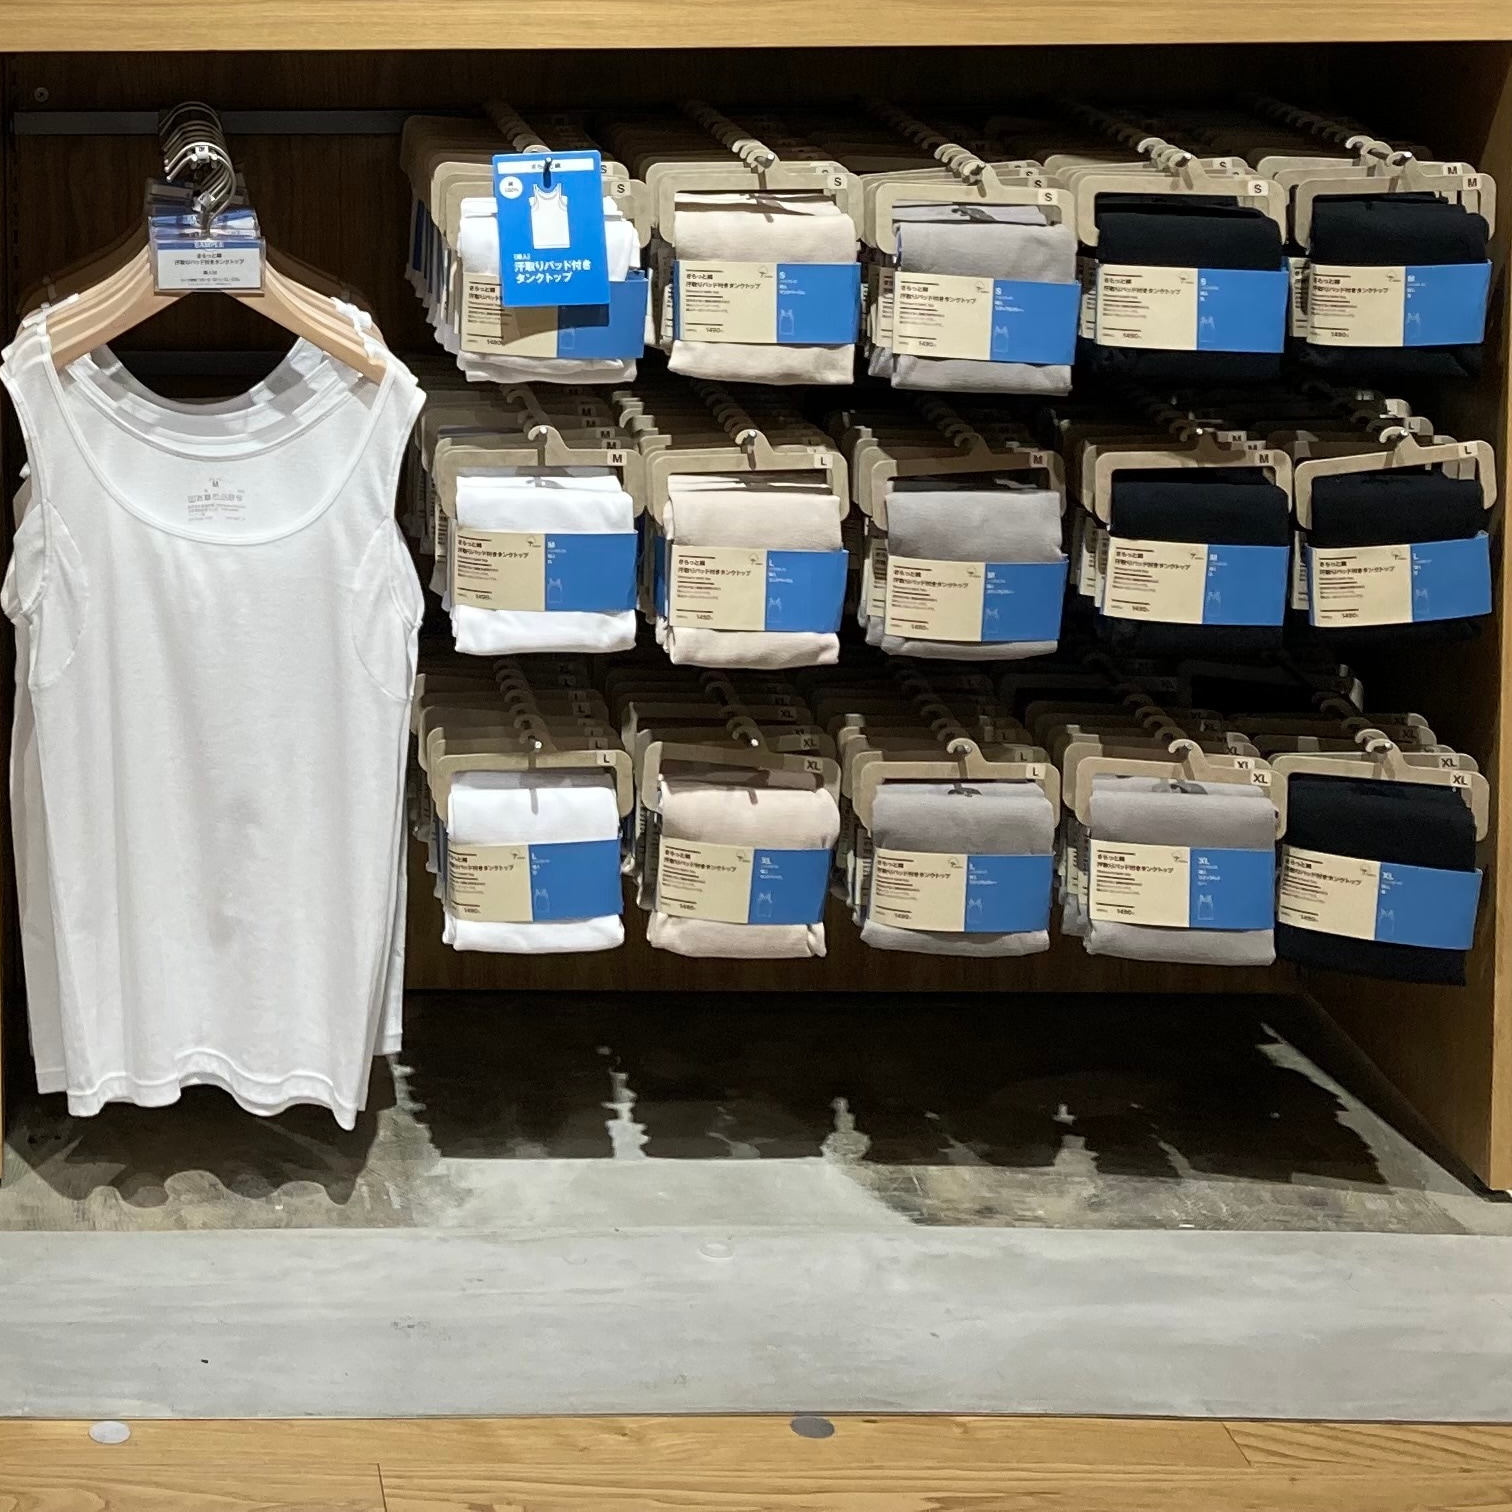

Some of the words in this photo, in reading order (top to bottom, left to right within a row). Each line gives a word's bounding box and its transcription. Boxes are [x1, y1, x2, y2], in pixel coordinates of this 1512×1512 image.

[834, 177, 842, 187] S
[1467, 178, 1478, 187] M
[616, 184, 625, 194] S
[1254, 184, 1262, 193] S
[1044, 192, 1053, 202] S
[514, 259, 591, 273] 汗取りパッド付き
[516, 271, 573, 284] タンクトップ
[1465, 446, 1472, 454] L
[613, 454, 622, 463] M
[820, 457, 827, 466] L
[1033, 456, 1043, 464] M
[1259, 454, 1269, 463] M
[803, 739, 816, 747] XL
[603, 754, 610, 763] L
[1020, 752, 1028, 760] L
[807, 760, 822, 769] XL
[1441, 758, 1457, 767] XL
[1032, 767, 1039, 776] L
[1253, 774, 1268, 784] XL
[1453, 775, 1467, 785] XL
